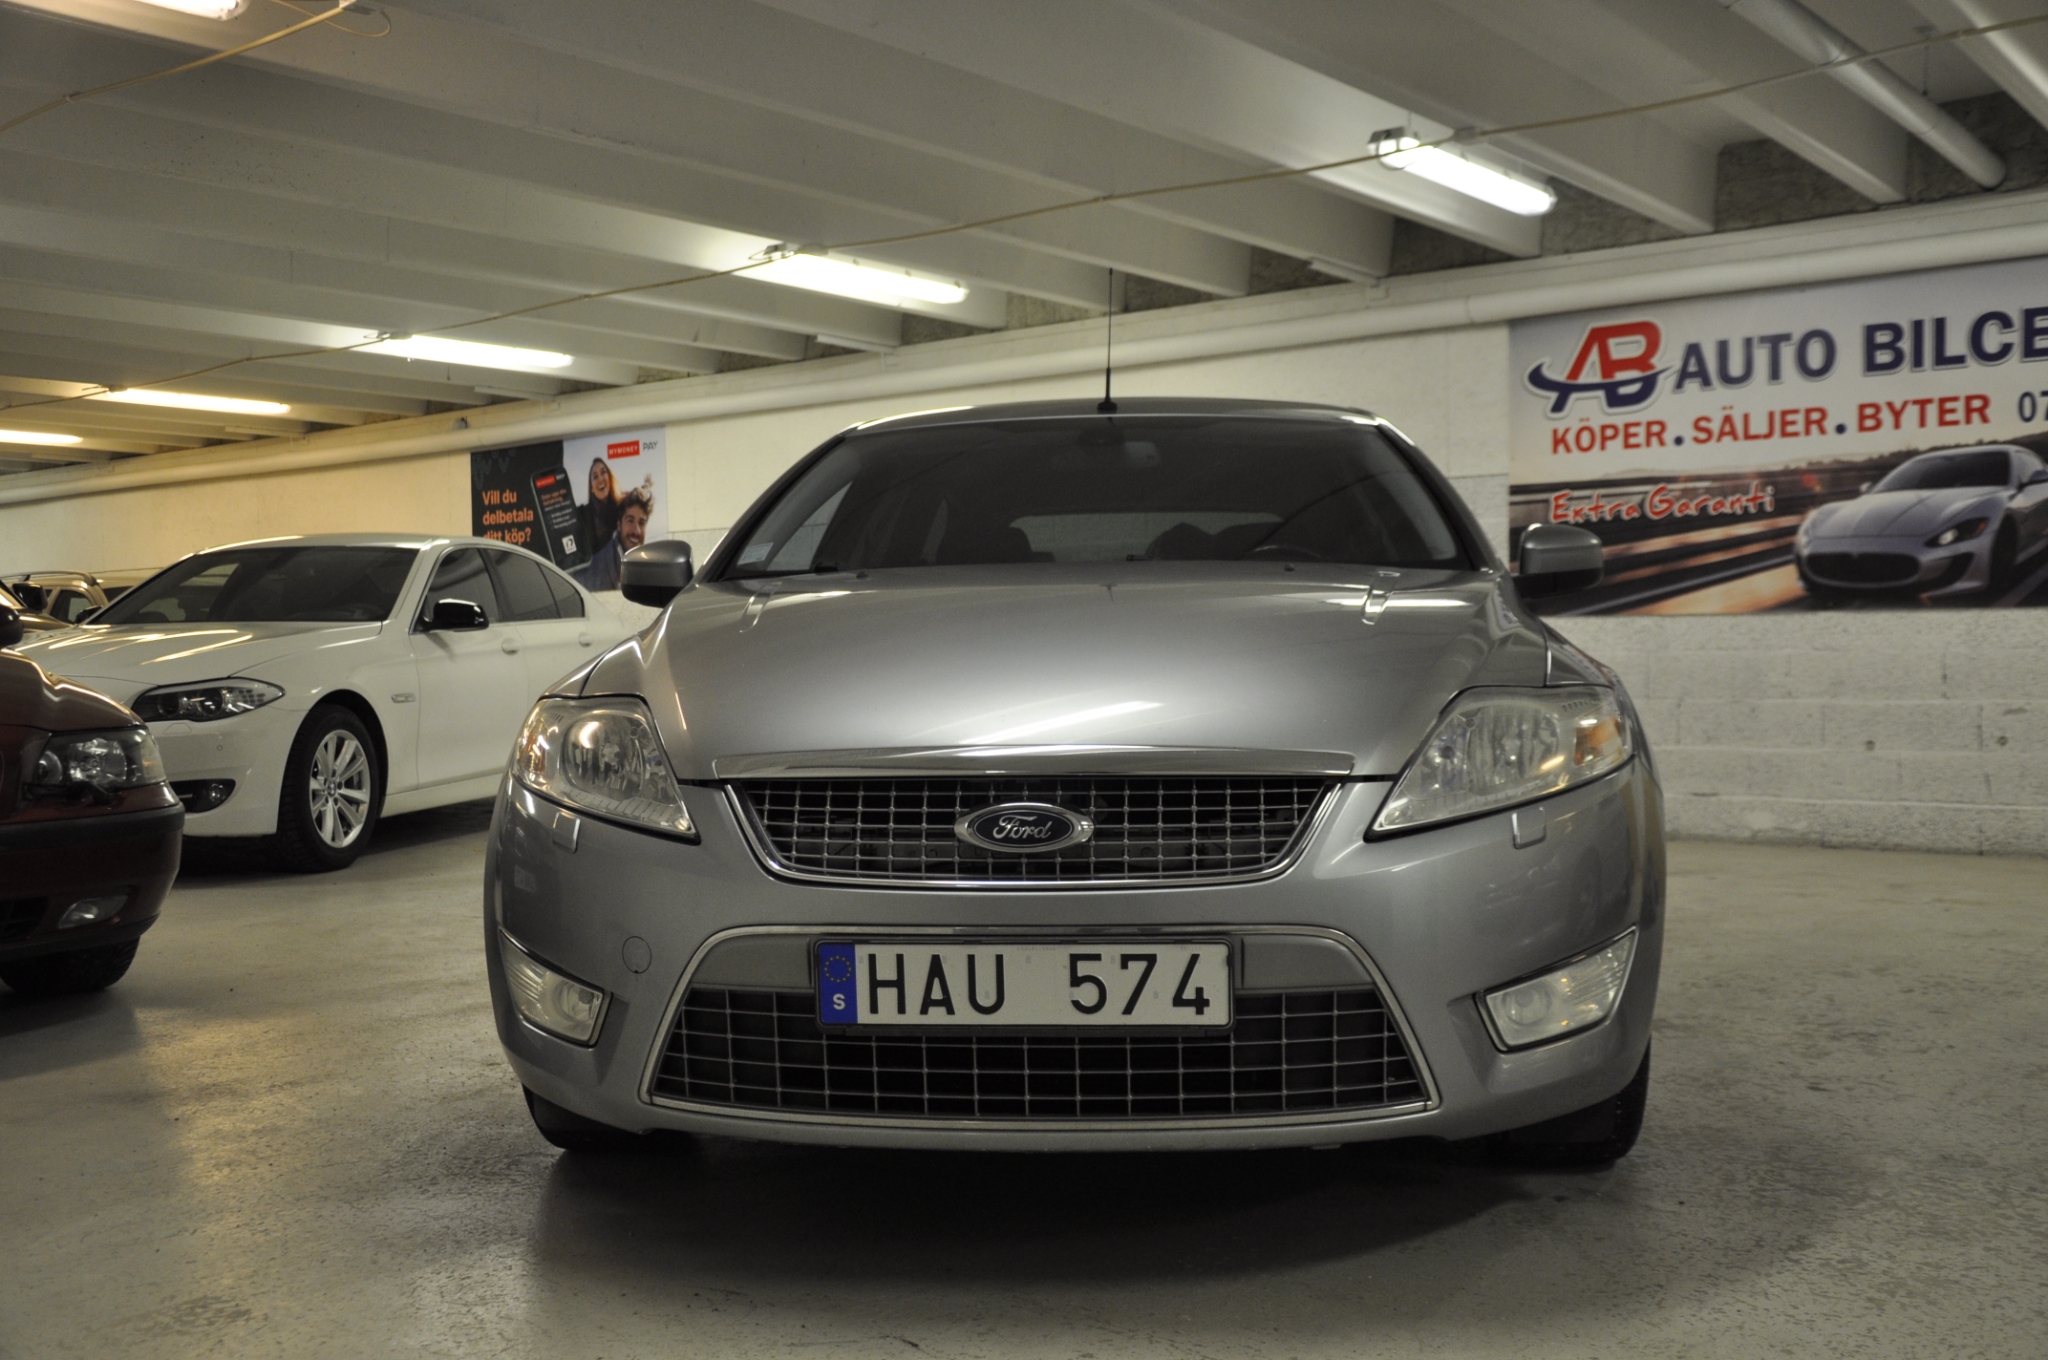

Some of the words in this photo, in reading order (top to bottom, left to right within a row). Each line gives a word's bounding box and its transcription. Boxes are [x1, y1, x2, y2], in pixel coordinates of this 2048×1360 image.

[1674, 328, 1837, 390] AUTO
[1865, 306, 2048, 373] BILCE
[1552, 417, 1668, 455] KÖPER
[1692, 405, 1829, 445] SÄLJER
[1857, 393, 1992, 433] BYTER
[608, 445, 639, 456] MYMONEY
[642, 440, 658, 451] PAY
[482, 490, 500, 505] Vill
[502, 489, 517, 504] du
[1551, 490, 1641, 523] Extra
[1647, 482, 1775, 519] Garanti
[482, 507, 534, 526] delbetala
[504, 527, 532, 546] köp?
[993, 814, 1053, 840] Ford
[868, 953, 1006, 1015] HAU
[1069, 953, 1211, 1015] 574
[832, 993, 847, 1011] S
